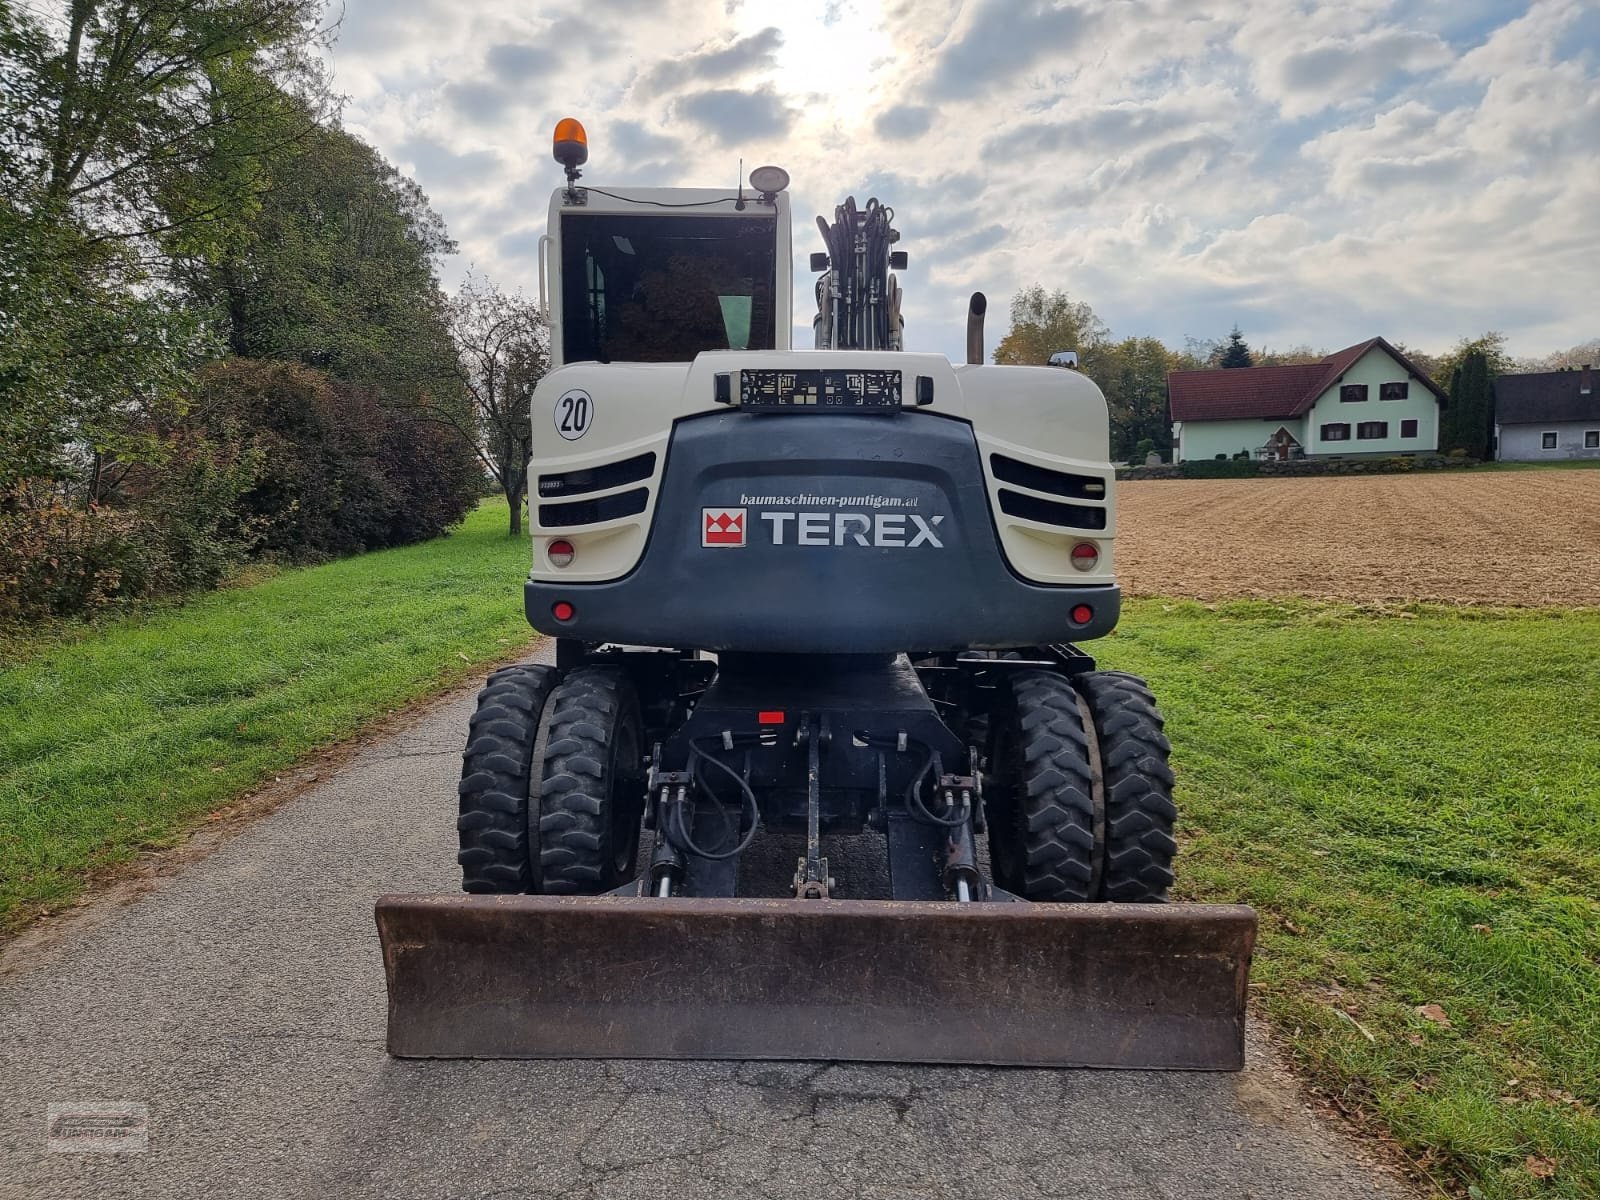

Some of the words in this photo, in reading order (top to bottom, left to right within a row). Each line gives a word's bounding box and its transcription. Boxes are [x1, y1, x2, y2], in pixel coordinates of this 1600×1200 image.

[560, 397, 588, 432] 20
[740, 493, 919, 509] baumaschinen-puntigam.at
[760, 511, 945, 548] TEREX
